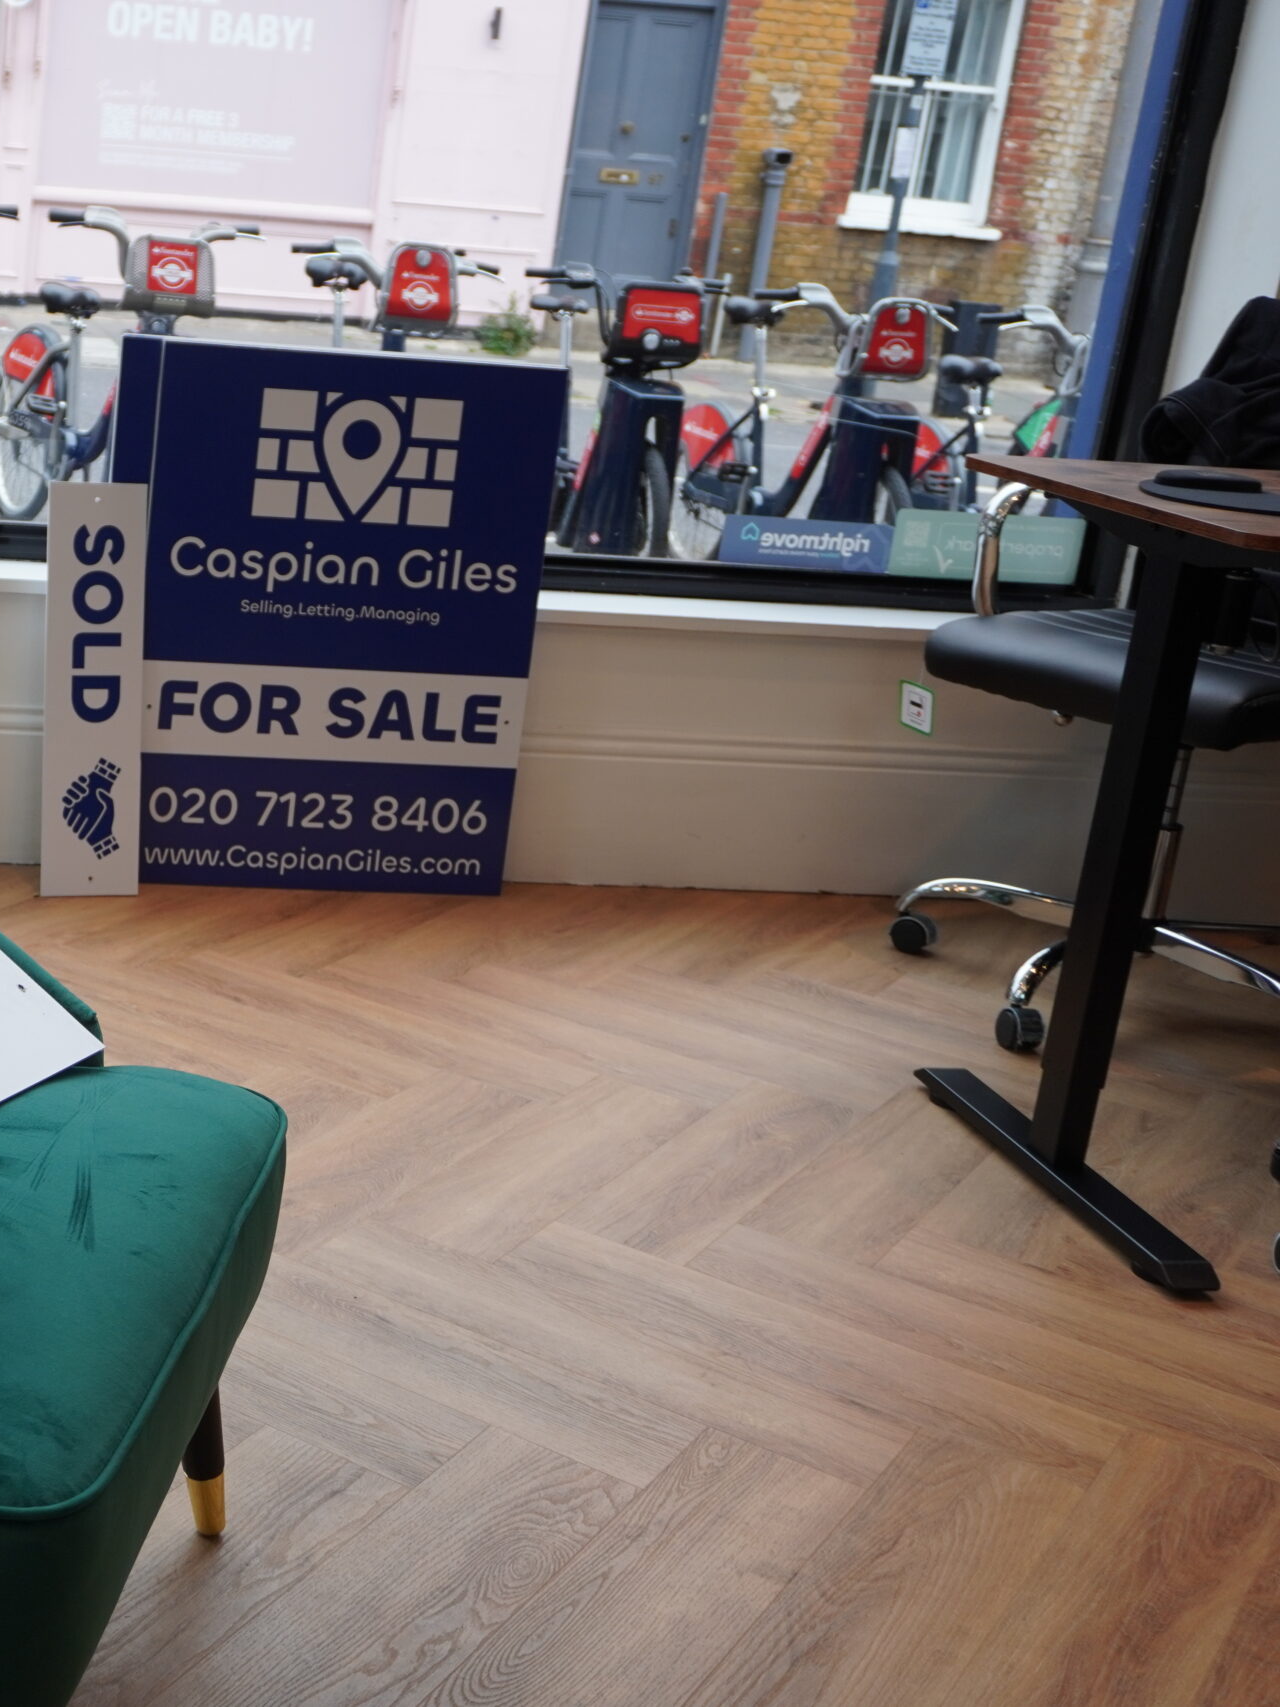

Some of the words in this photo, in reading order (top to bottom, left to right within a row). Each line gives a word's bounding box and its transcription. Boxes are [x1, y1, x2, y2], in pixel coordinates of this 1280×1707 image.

[107, 2, 199, 43] OPEN
[209, 12, 315, 53] BABY!
[170, 536, 380, 592] Caspian
[398, 548, 518, 594] Giles
[71, 524, 125, 723] SOLD
[240, 599, 441, 626] Selling.Letting.Managing
[157, 680, 302, 736] FOR
[325, 687, 502, 745] SALE
[149, 786, 238, 826] 020
[255, 790, 354, 830] 7123
[370, 795, 488, 835] 8406
[144, 845, 481, 876] www.CaspianGiles.com
